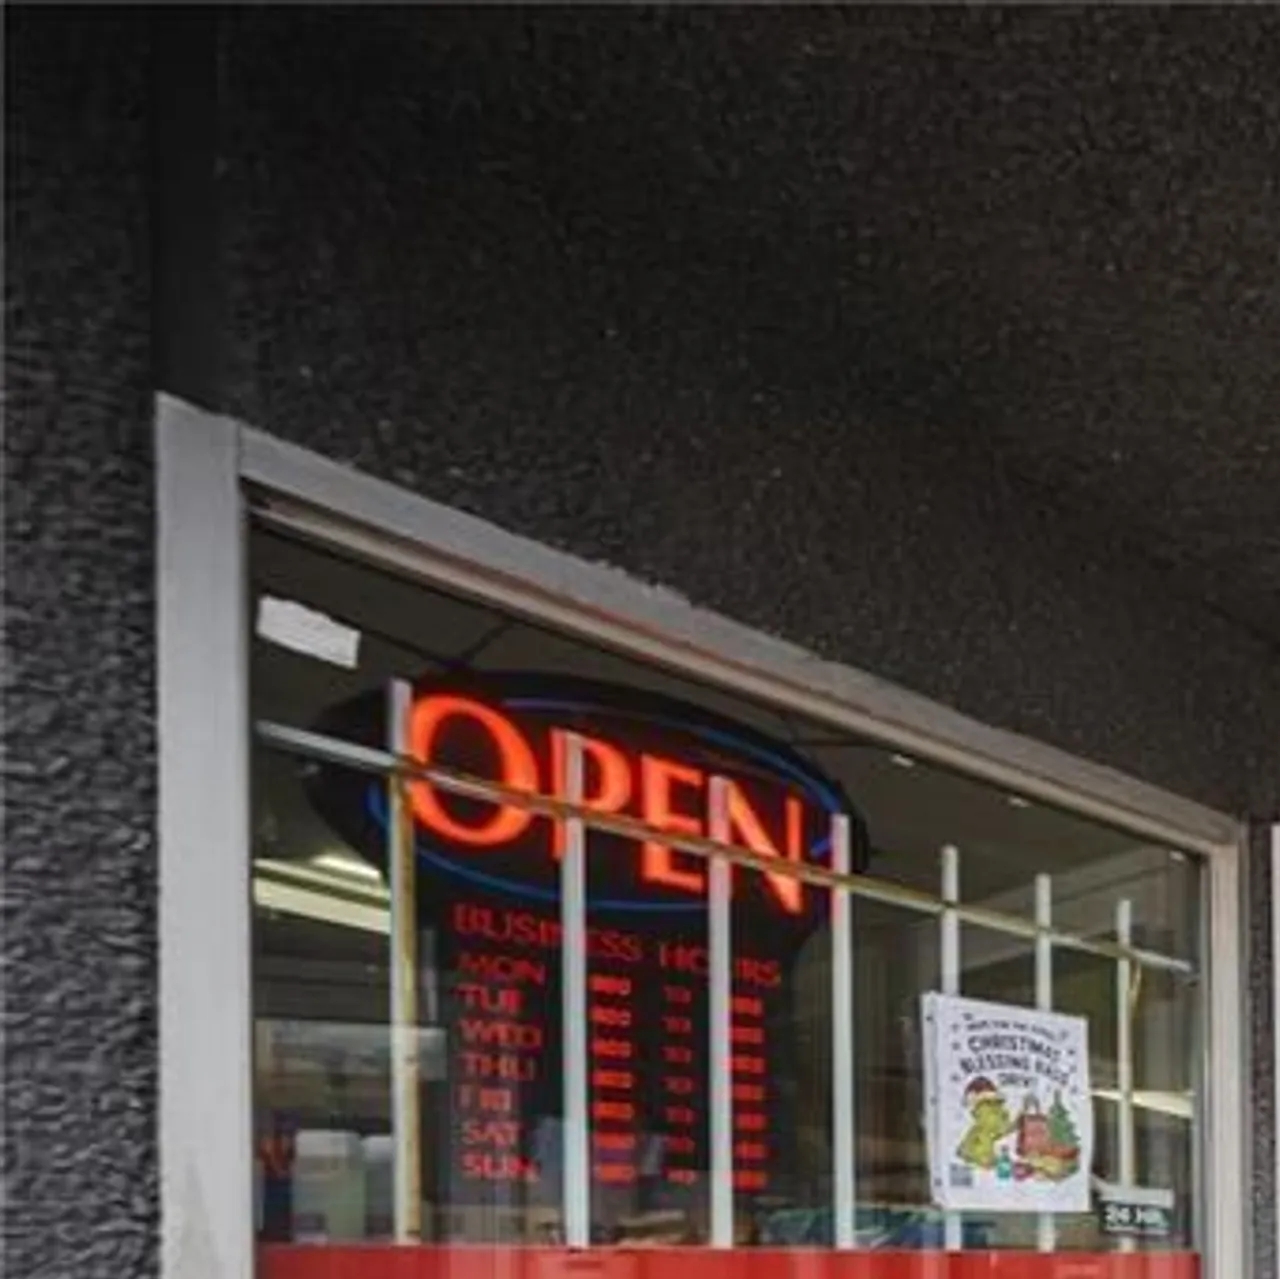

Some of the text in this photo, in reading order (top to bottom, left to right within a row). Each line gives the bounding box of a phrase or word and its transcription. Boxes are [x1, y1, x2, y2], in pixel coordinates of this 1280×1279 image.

[405, 692, 803, 915] OPEN
[659, 942, 782, 987] HORS
[459, 1120, 520, 1148] SAT
[461, 1152, 541, 1183] SUN
